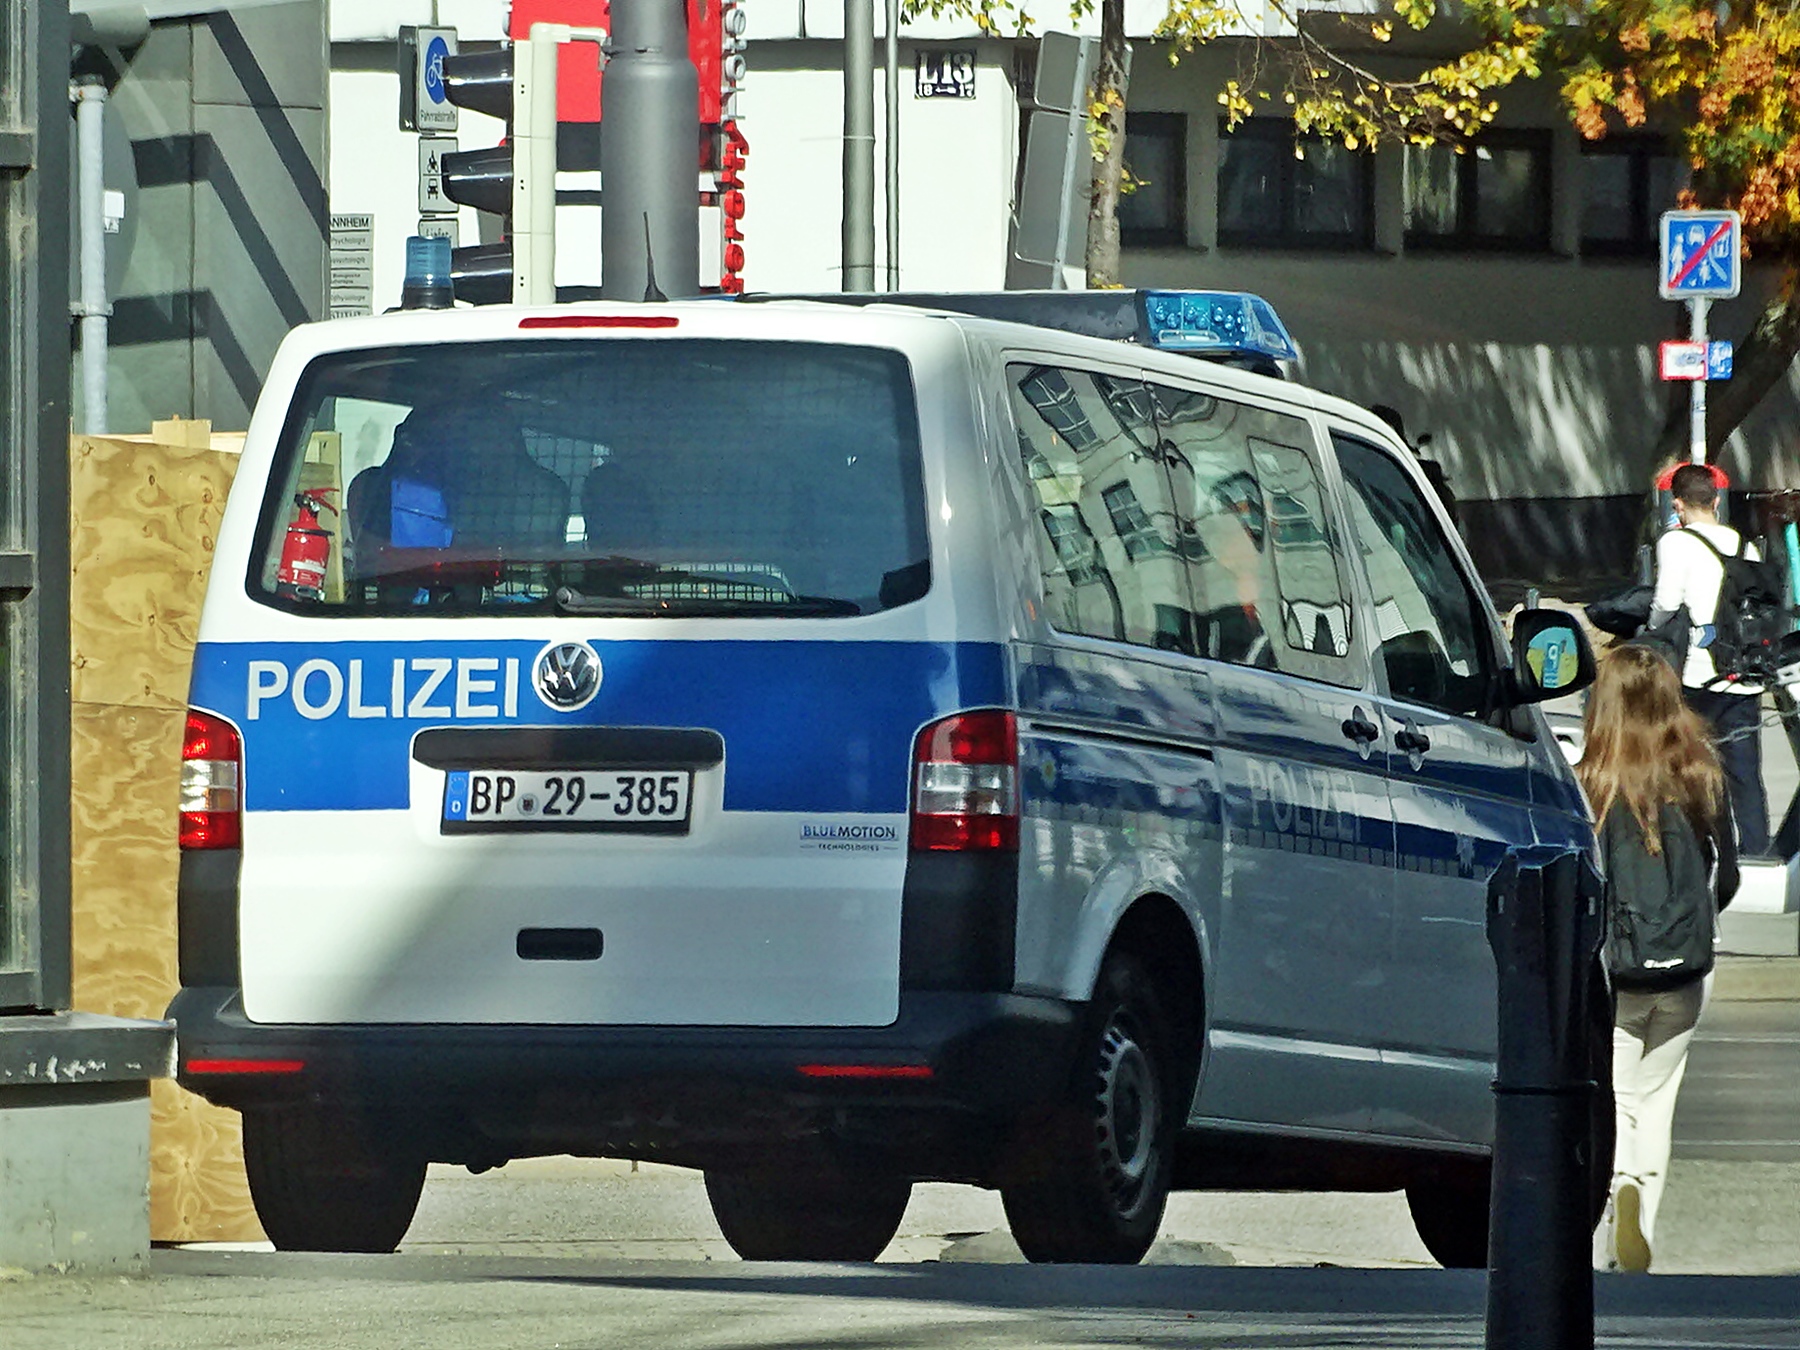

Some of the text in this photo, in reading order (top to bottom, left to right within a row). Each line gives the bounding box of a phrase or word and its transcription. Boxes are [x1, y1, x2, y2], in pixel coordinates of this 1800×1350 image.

[959, 83, 974, 97] 17
[247, 657, 520, 721] POLIZEI
[470, 775, 516, 816] BP
[542, 776, 681, 817] 29-385
[803, 825, 897, 839] BLUEMOTION
